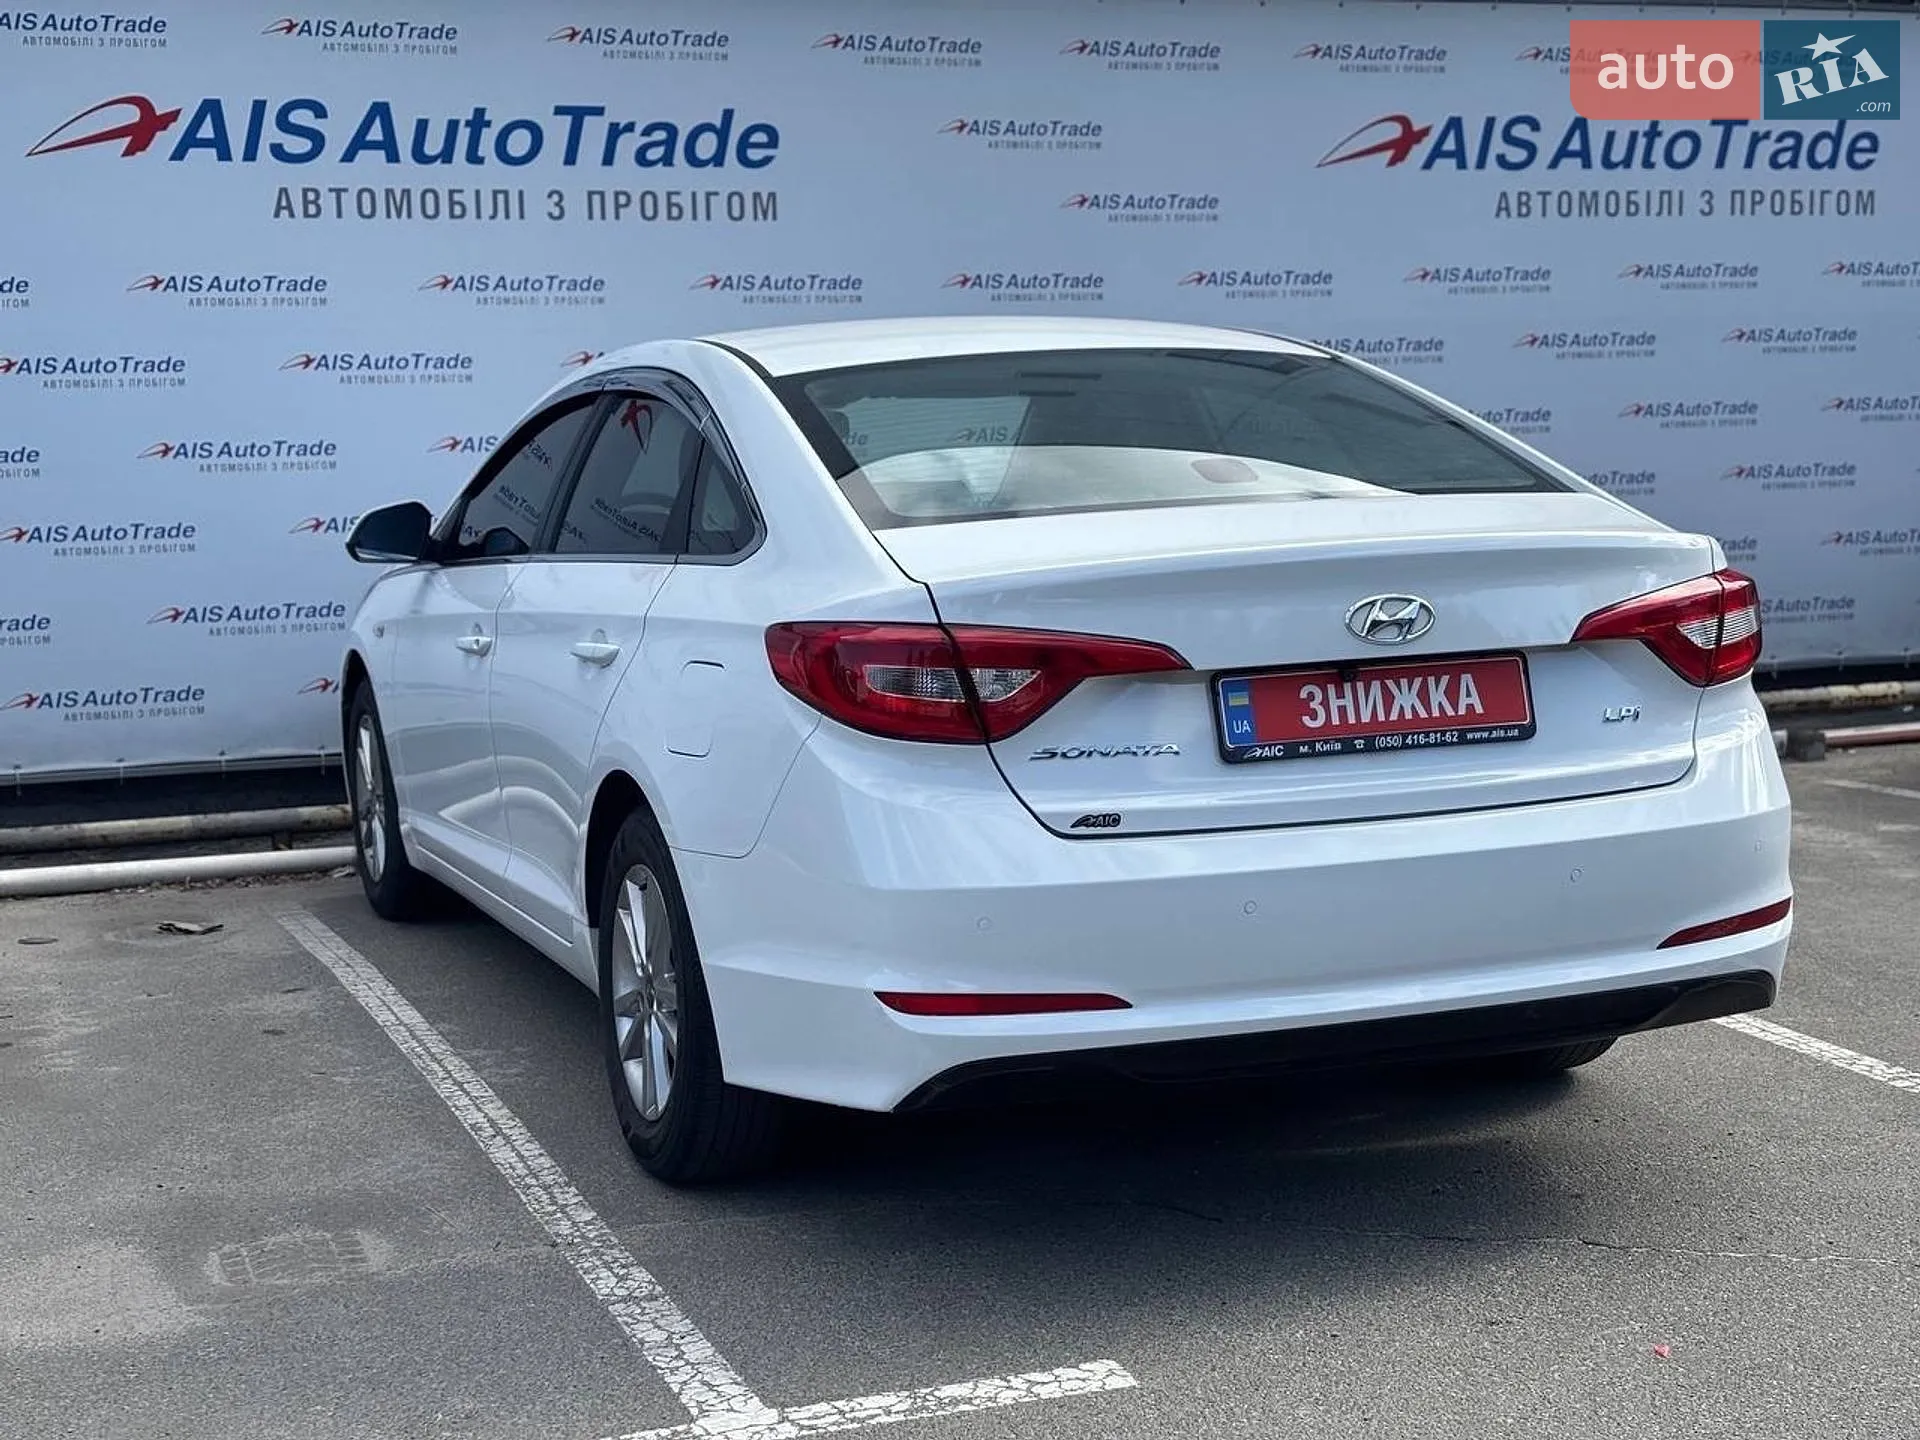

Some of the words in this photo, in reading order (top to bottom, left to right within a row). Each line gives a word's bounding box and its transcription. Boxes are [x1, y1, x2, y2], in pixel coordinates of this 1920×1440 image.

[40, 13, 167, 34] AutoTrade
[297, 20, 337, 37] AIS
[340, 21, 458, 41] AutoTrade
[578, 28, 615, 45] AIS
[619, 29, 729, 47] AutoTrade
[841, 34, 877, 51] AIS
[879, 36, 982, 54] AutoTrade
[1086, 41, 1121, 57] AIS
[1123, 42, 1220, 58] AutoTrade
[1319, 45, 1352, 60] AIS
[1354, 45, 1447, 61] AutoTrade
[168, 98, 328, 165] AIS
[338, 101, 780, 169] AutoTrade
[967, 120, 1001, 136] AIS
[1003, 120, 1102, 137] AutoTrade
[1419, 115, 1542, 172] AIS
[1546, 117, 1880, 172] AutoTrade
[272, 187, 527, 220] АВТОМОБІЛІ
[546, 189, 566, 221] З
[586, 190, 778, 222] ПРОБІГОМ
[1086, 194, 1121, 210] AIS
[1123, 194, 1219, 209] AutoTrade
[1494, 190, 1684, 219] АВТОМОБІЛІ
[1699, 190, 1715, 217] З
[1730, 189, 1876, 216] ПРОБІГОМ
[719, 274, 756, 291] AIS
[758, 274, 862, 291] AutoTrade
[970, 273, 1004, 289] AIS
[1005, 273, 1104, 289] AutoTrade
[1205, 270, 1237, 287] AIS
[1239, 270, 1333, 286] AutoTrade
[1429, 267, 1460, 282] AIS
[1462, 266, 1551, 282] AutoTrade
[161, 275, 204, 293] AIS
[206, 275, 327, 292] AutoTrade
[450, 275, 490, 292] AIS
[492, 275, 605, 292] AutoTrade
[16, 357, 58, 375] AIS
[61, 356, 186, 374] AutoTrade
[313, 353, 354, 371] AIS
[356, 353, 473, 370] AutoTrade
[1872, 396, 1920, 410] AutoT
[172, 442, 214, 460] AIS
[216, 439, 337, 458] AutoTrade
[25, 525, 69, 544] AIS
[72, 522, 196, 542] AutoTrade
[1872, 529, 1920, 543] AutoT
[182, 606, 223, 624] AIS
[226, 601, 346, 622] AutoTrade
[37, 690, 79, 709] AIS
[82, 685, 205, 706] AutoTrade
[1300, 673, 1484, 729] ЗНИЖКА
[1233, 719, 1251, 733] UA
[1315, 740, 1342, 752] Київ
[1375, 735, 1402, 750] (050)
[1405, 731, 1459, 745] 416-81-62
[1029, 743, 1181, 761] SONATA
